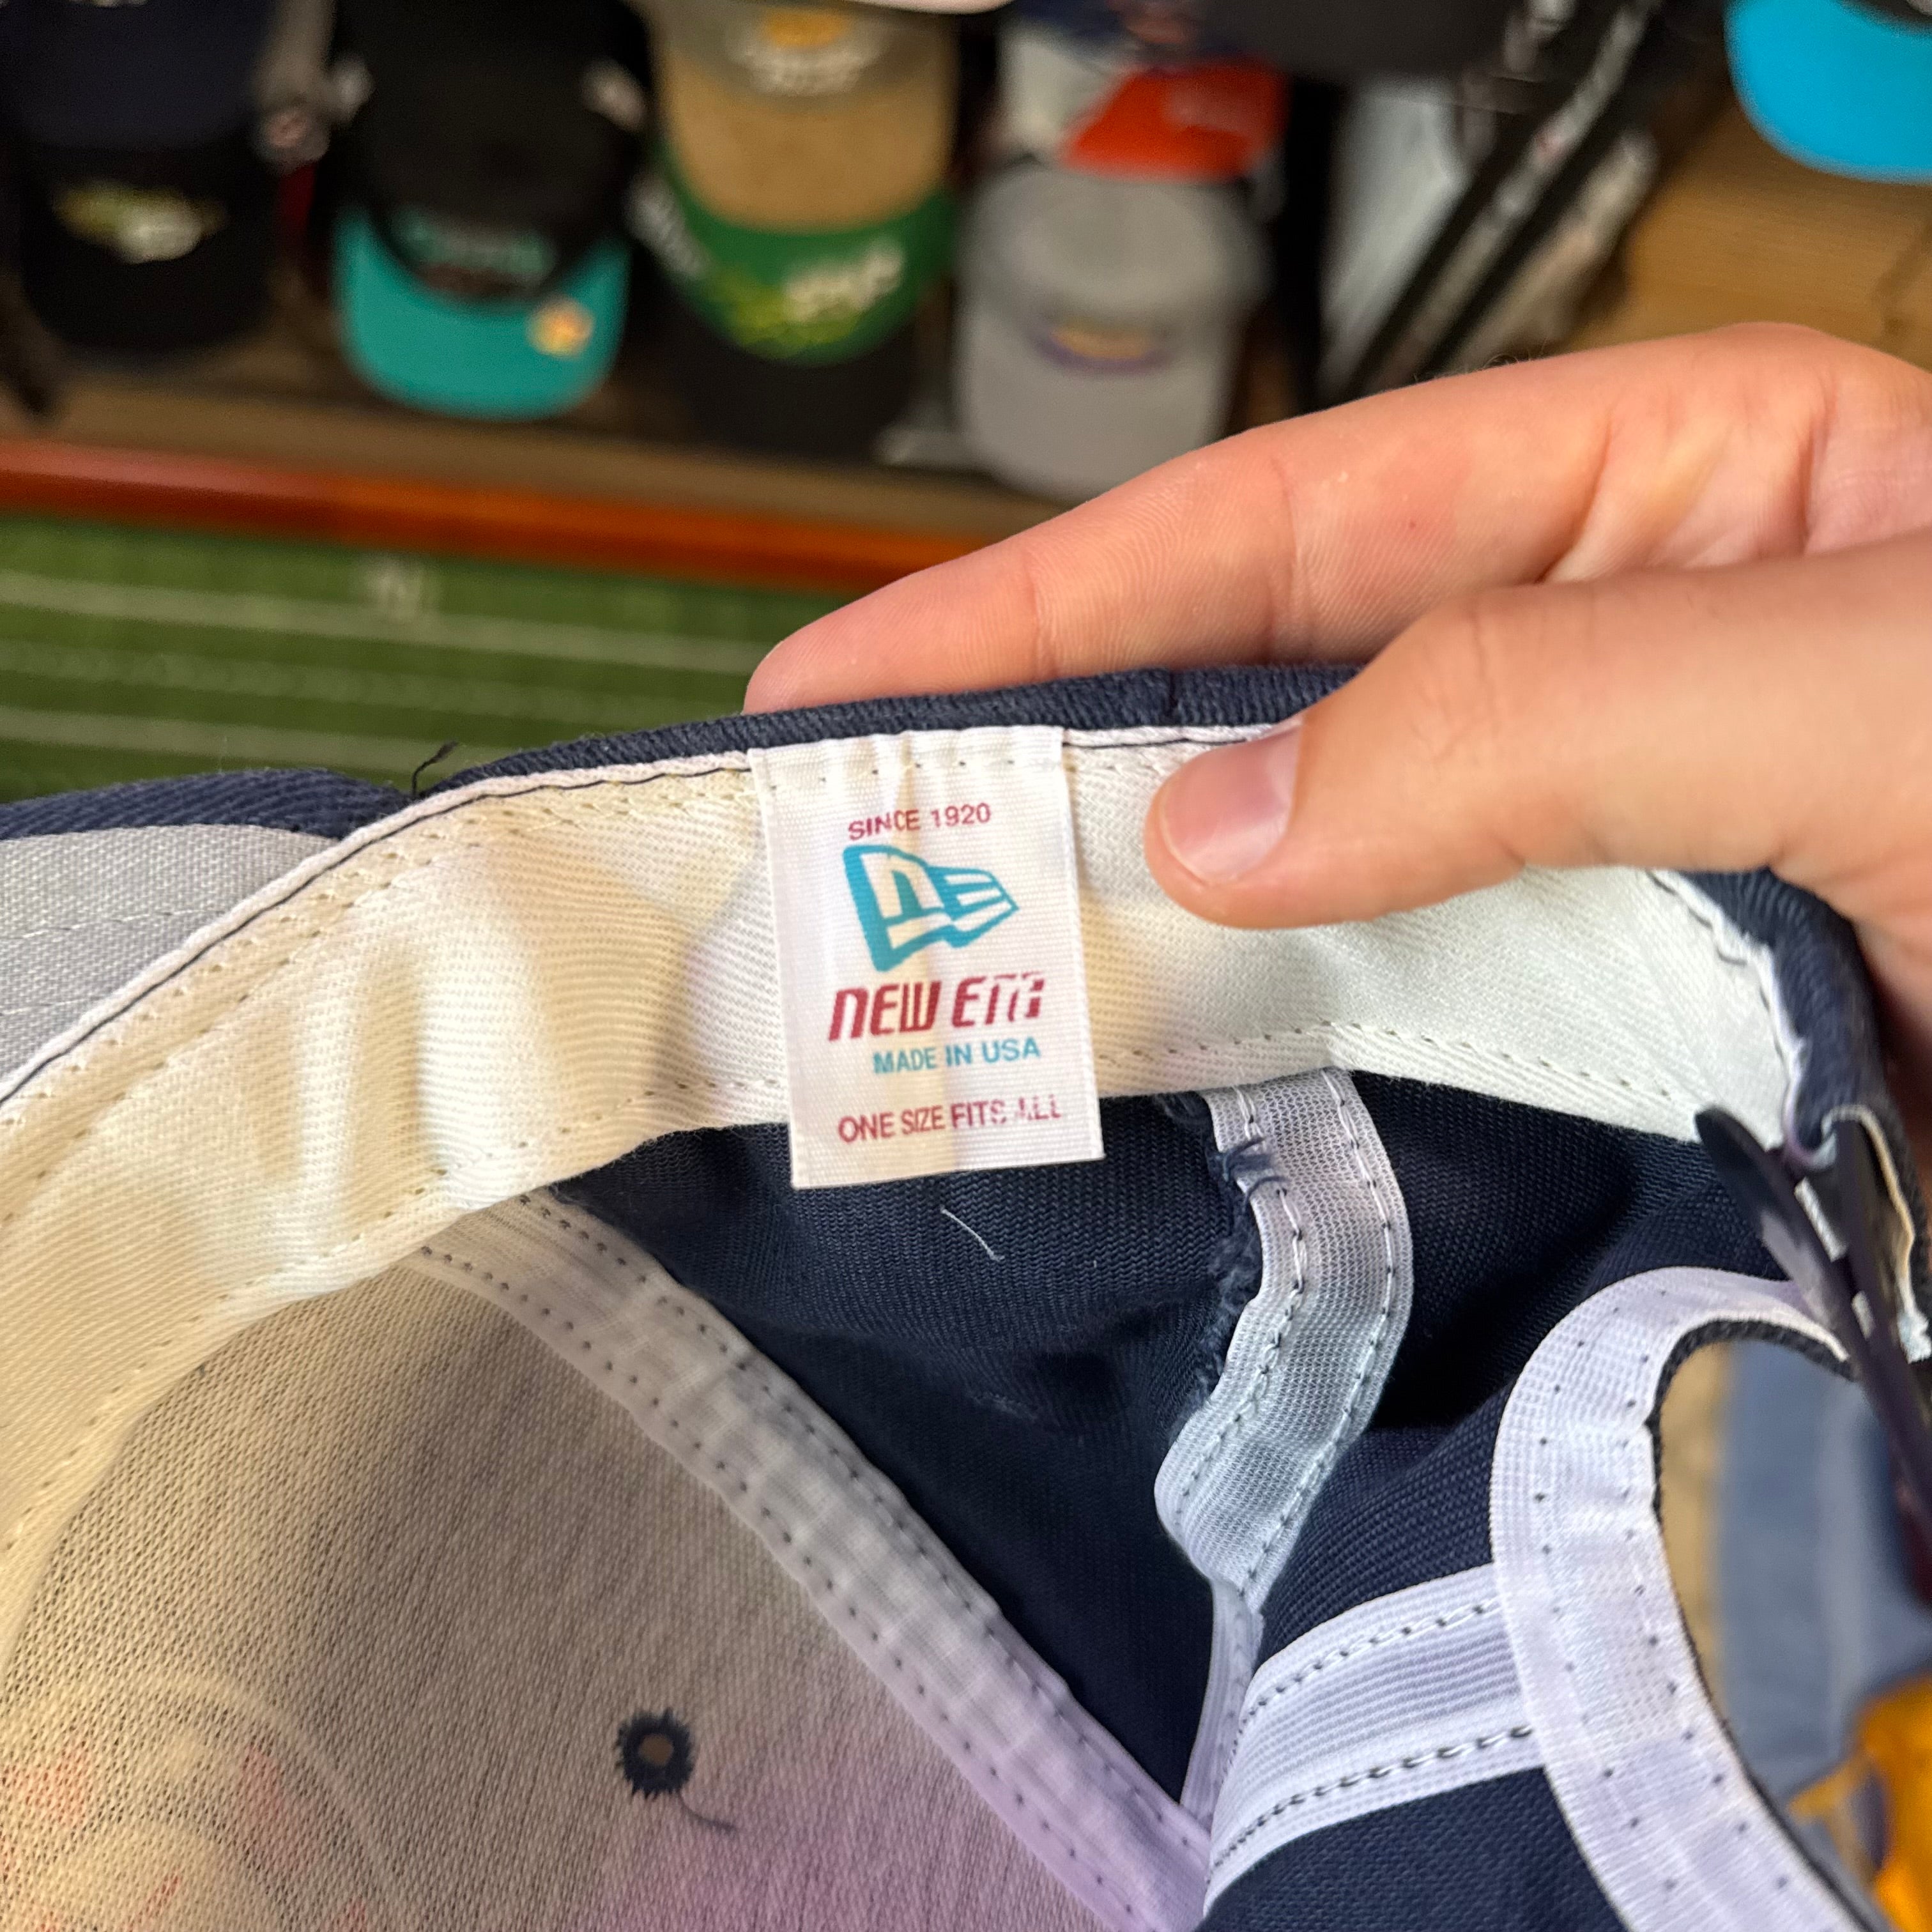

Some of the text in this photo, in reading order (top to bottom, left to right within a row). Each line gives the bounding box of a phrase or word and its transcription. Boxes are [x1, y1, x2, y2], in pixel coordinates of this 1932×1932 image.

[848, 802, 991, 841] SINCE 1920
[828, 980, 941, 1041] NEW
[873, 1035, 1041, 1075] MADE IN USA
[838, 1111, 894, 1143] ONE
[900, 1104, 946, 1135] SIZE
[950, 1098, 1006, 1129] FITS
